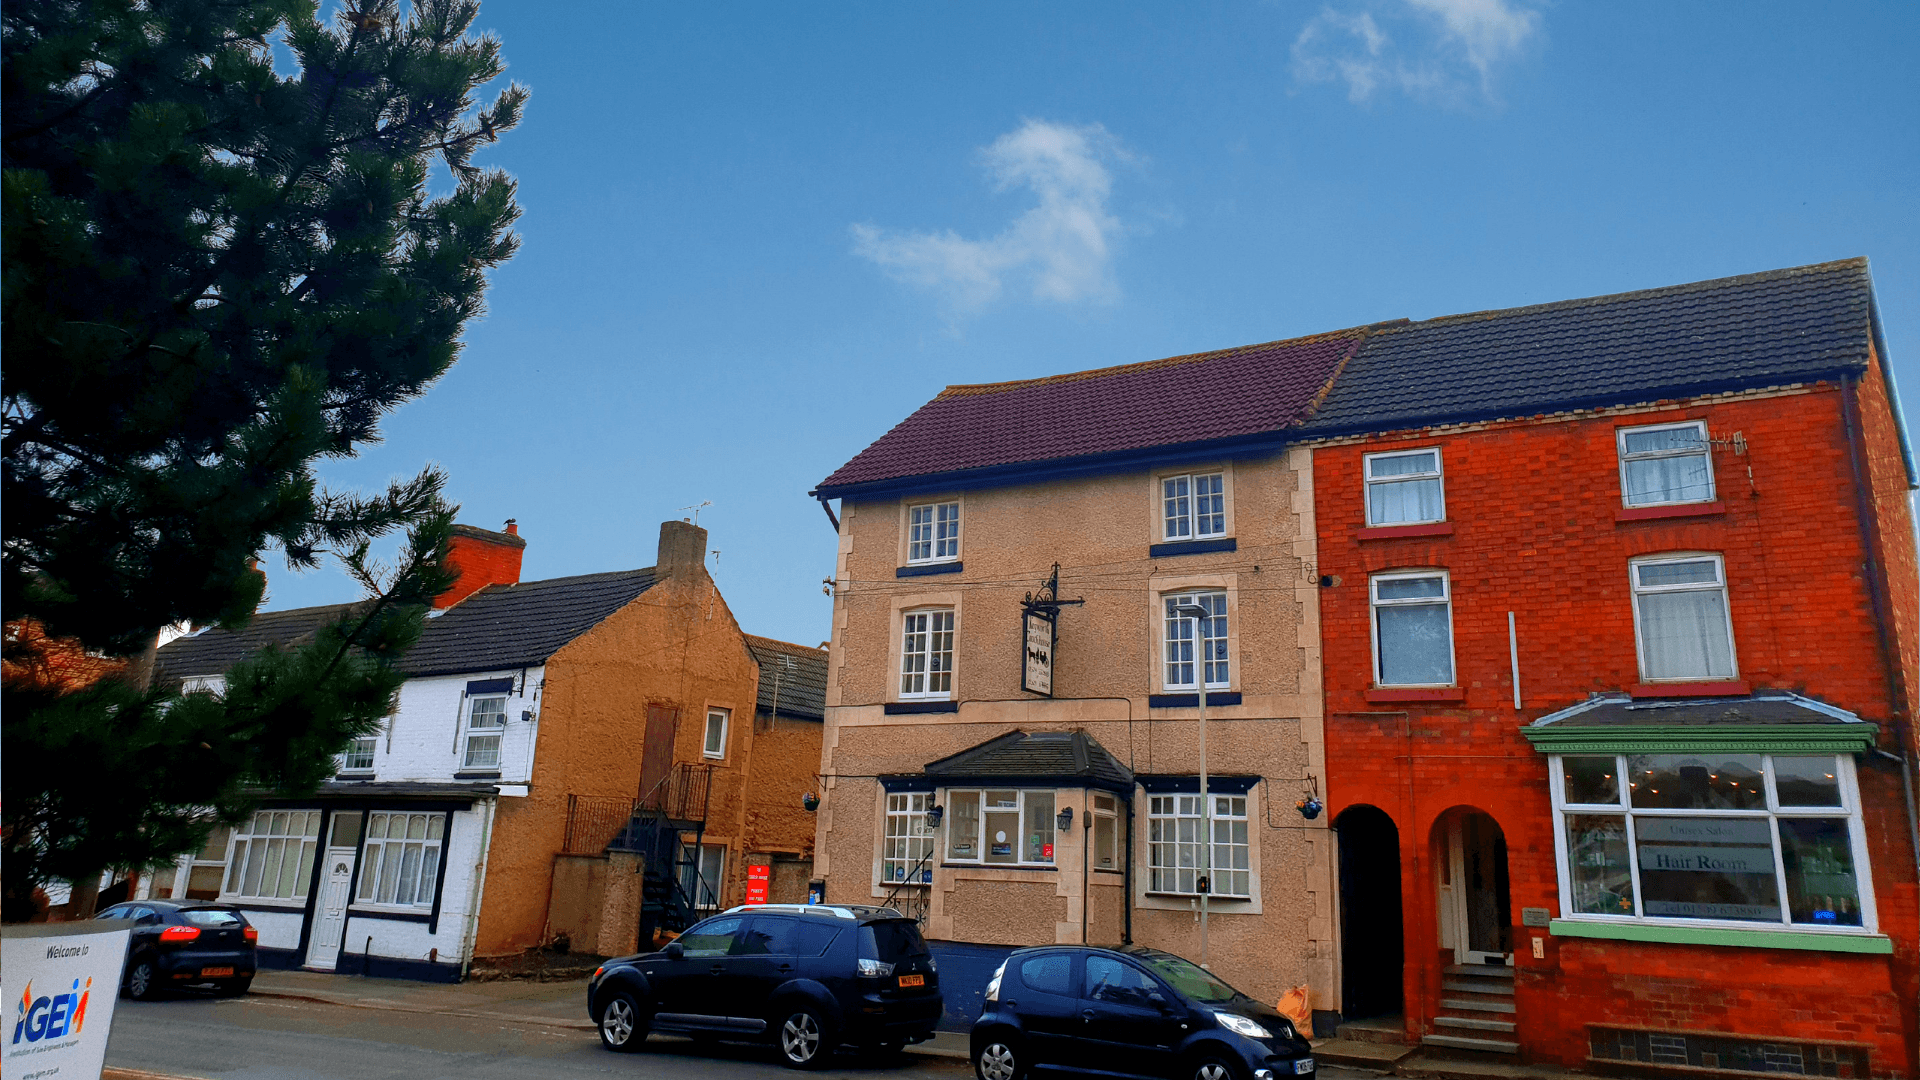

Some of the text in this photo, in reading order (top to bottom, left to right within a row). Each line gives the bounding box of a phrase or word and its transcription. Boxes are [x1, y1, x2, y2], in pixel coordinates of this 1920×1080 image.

[1669, 825, 1734, 836] Unisex Salon
[1656, 853, 1747, 870] Hair Room
[46, 943, 89, 959] Welcome to
